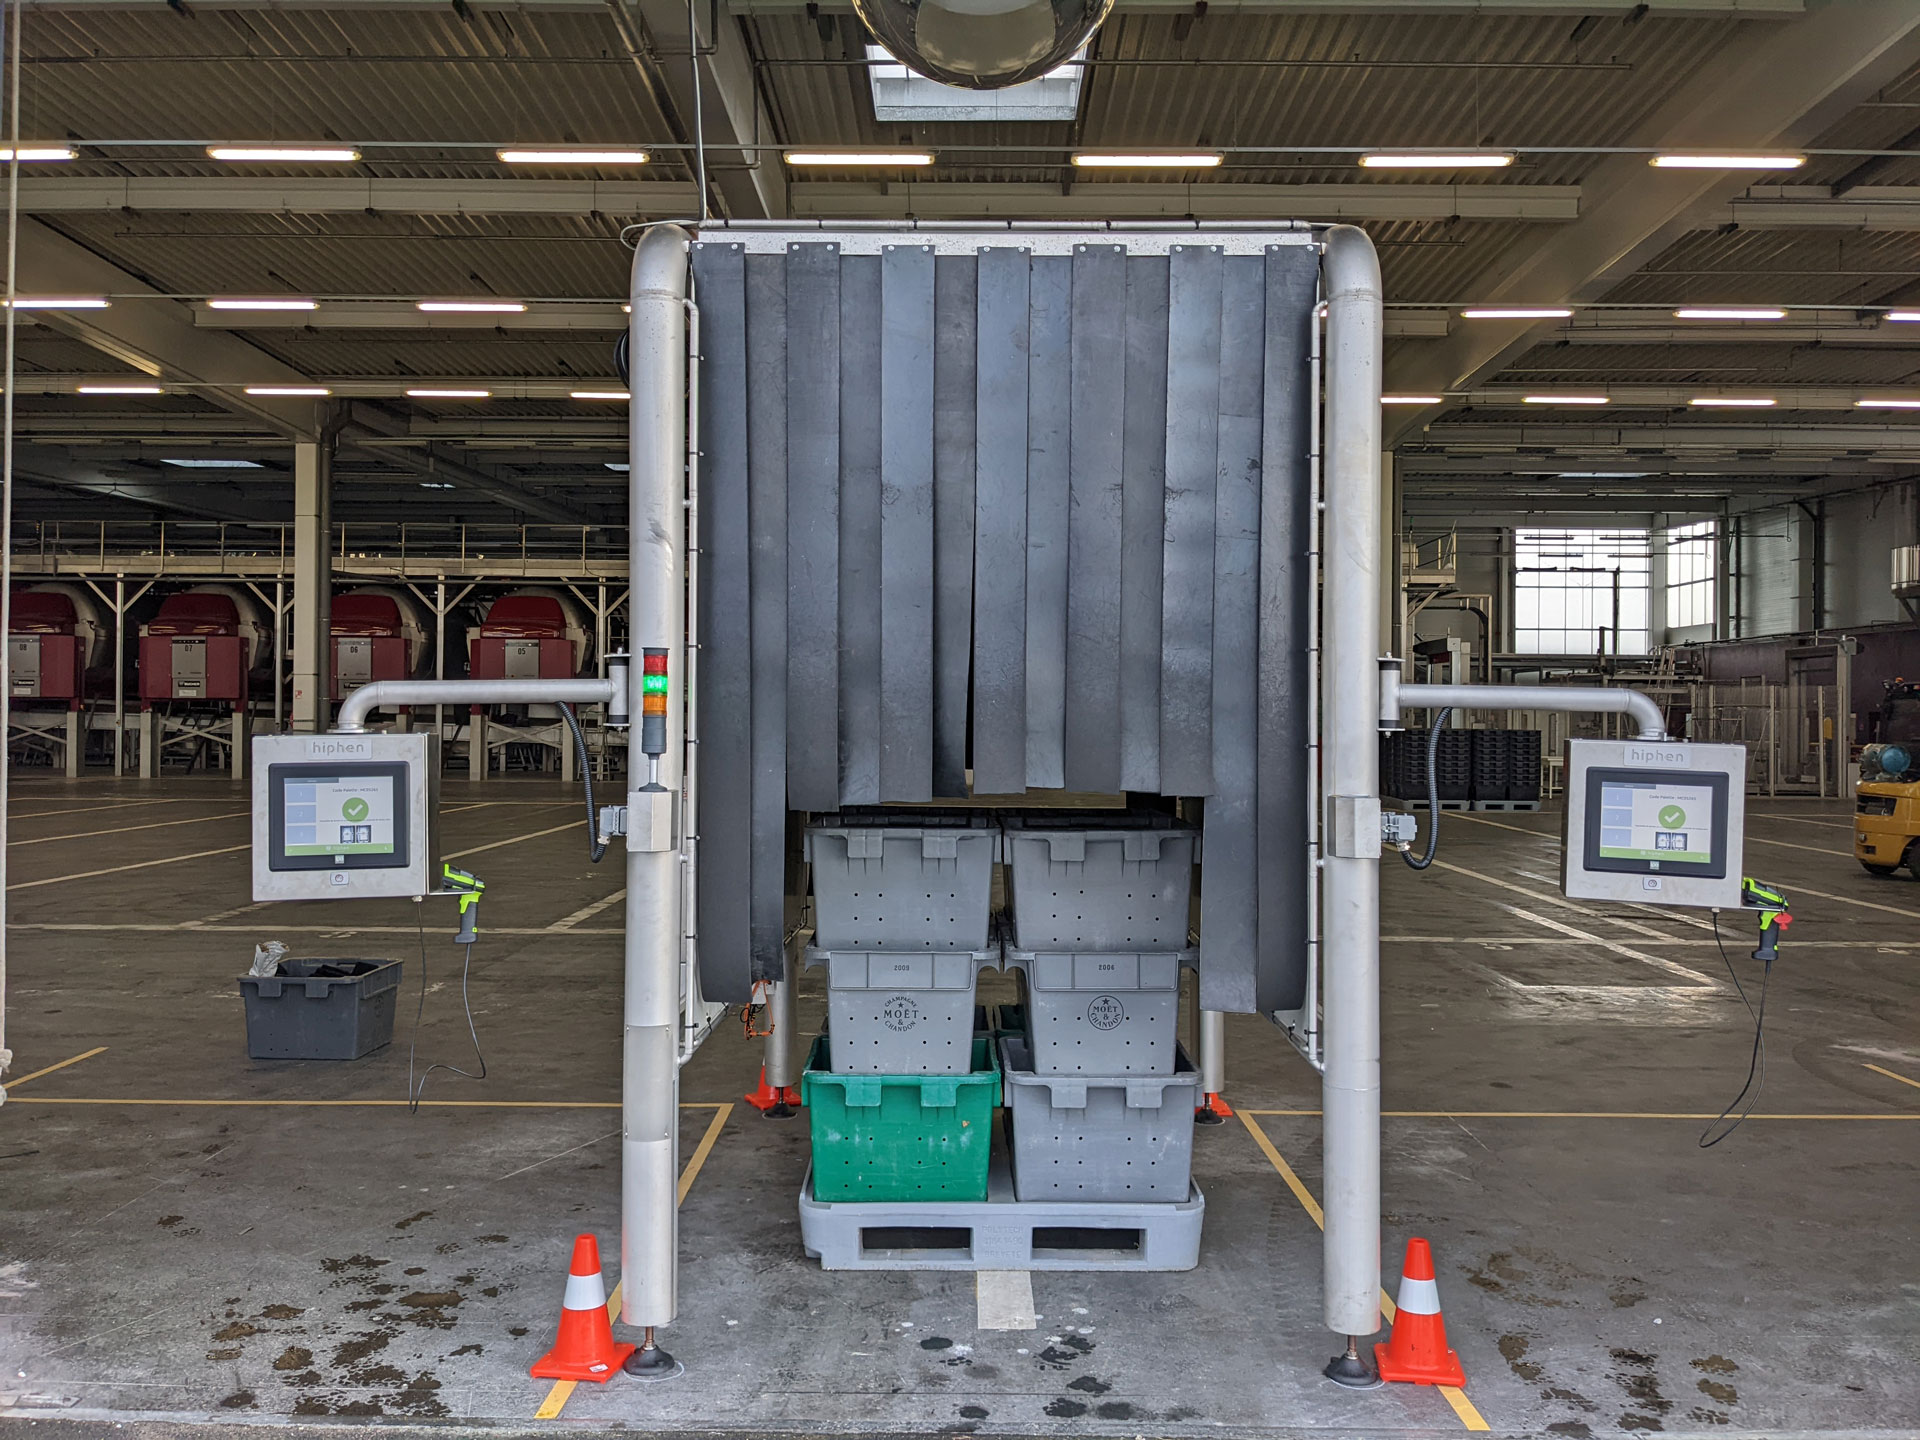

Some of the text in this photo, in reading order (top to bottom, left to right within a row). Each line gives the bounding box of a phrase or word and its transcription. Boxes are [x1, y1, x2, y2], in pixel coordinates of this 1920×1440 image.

[184, 644, 193, 652] 07
[517, 647, 526, 655] 05
[313, 741, 364, 756] hiphen
[1631, 748, 1684, 763] hiphen
[884, 996, 918, 1007] CHAMPAGNE
[883, 1008, 919, 1019] MOËT
[1093, 1005, 1118, 1013] MOËT
[898, 1018, 903, 1026] &
[1090, 1012, 1121, 1028] CHANDON
[884, 1020, 916, 1032] CHANDON
